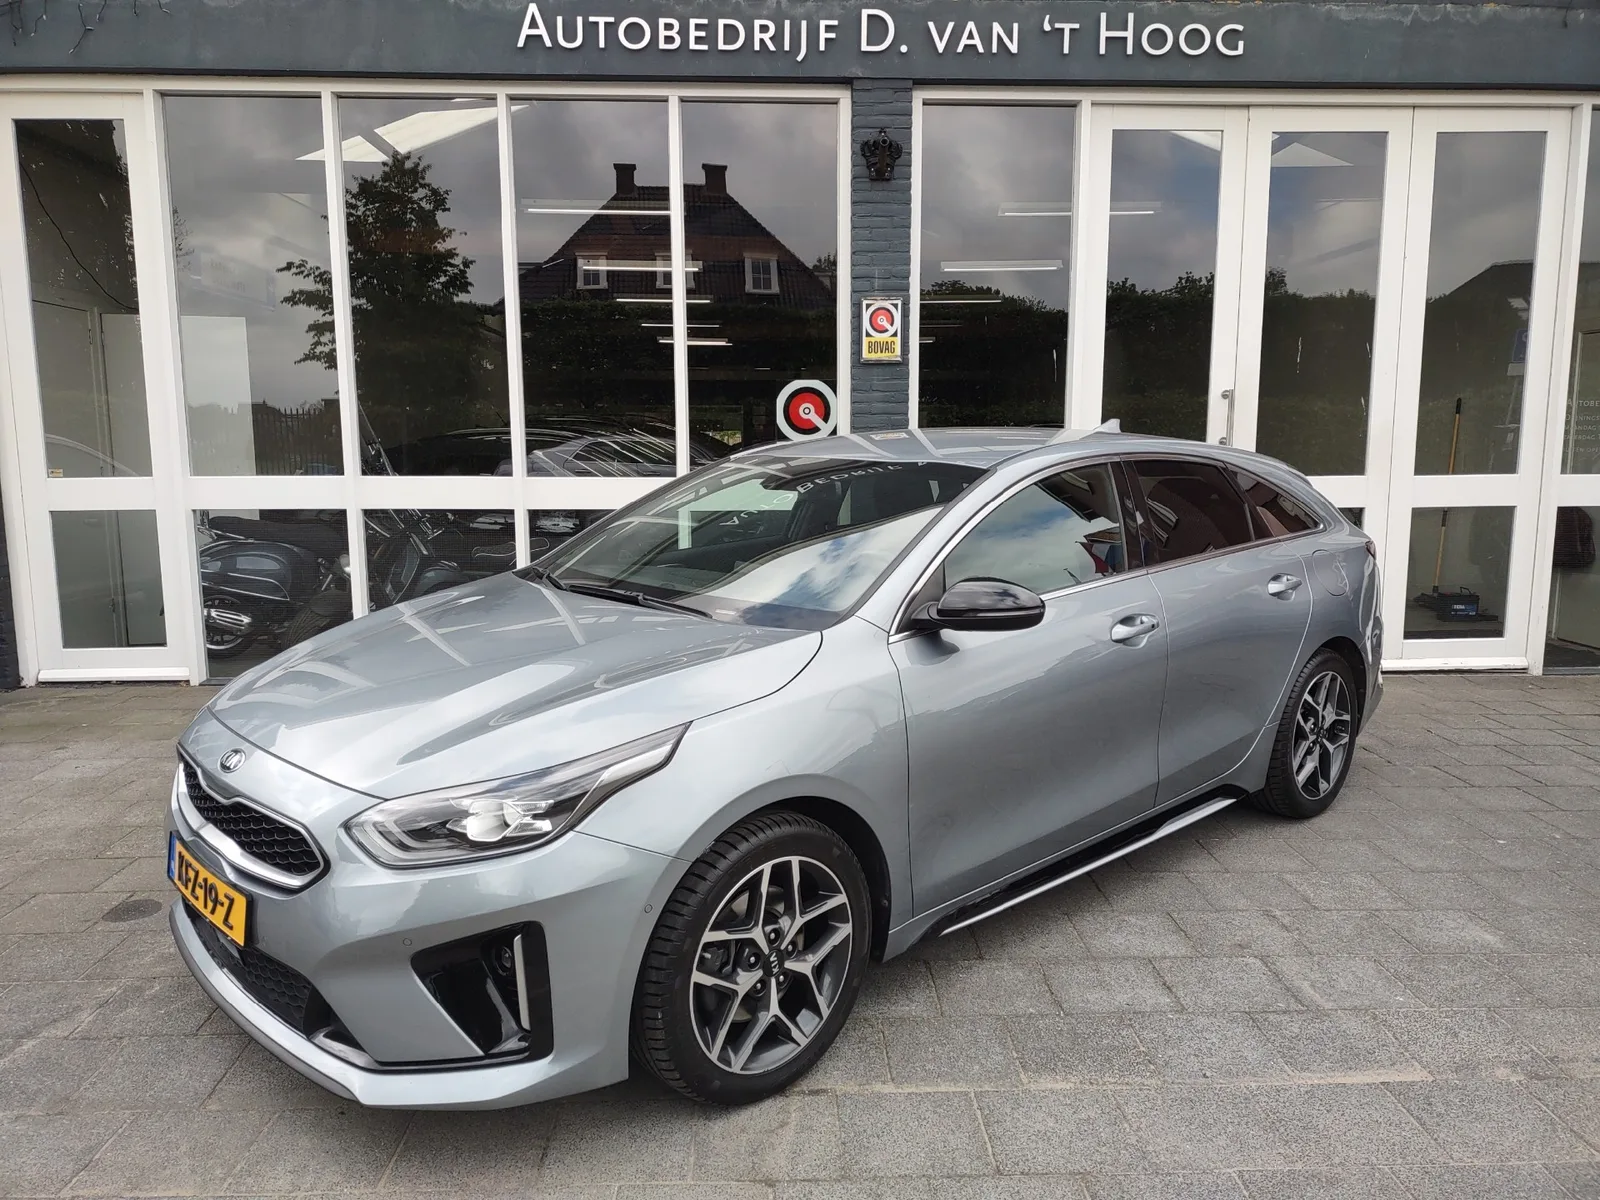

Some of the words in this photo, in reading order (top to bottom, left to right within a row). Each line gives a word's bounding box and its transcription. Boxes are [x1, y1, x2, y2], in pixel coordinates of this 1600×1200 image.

[516, 2, 839, 62] AUTOBEDRIJF
[860, 8, 908, 53] D.
[927, 21, 1019, 54] VAN
[1099, 12, 1244, 56] HOOG
[867, 340, 896, 354] BOVAG
[770, 952, 779, 974] KIA
